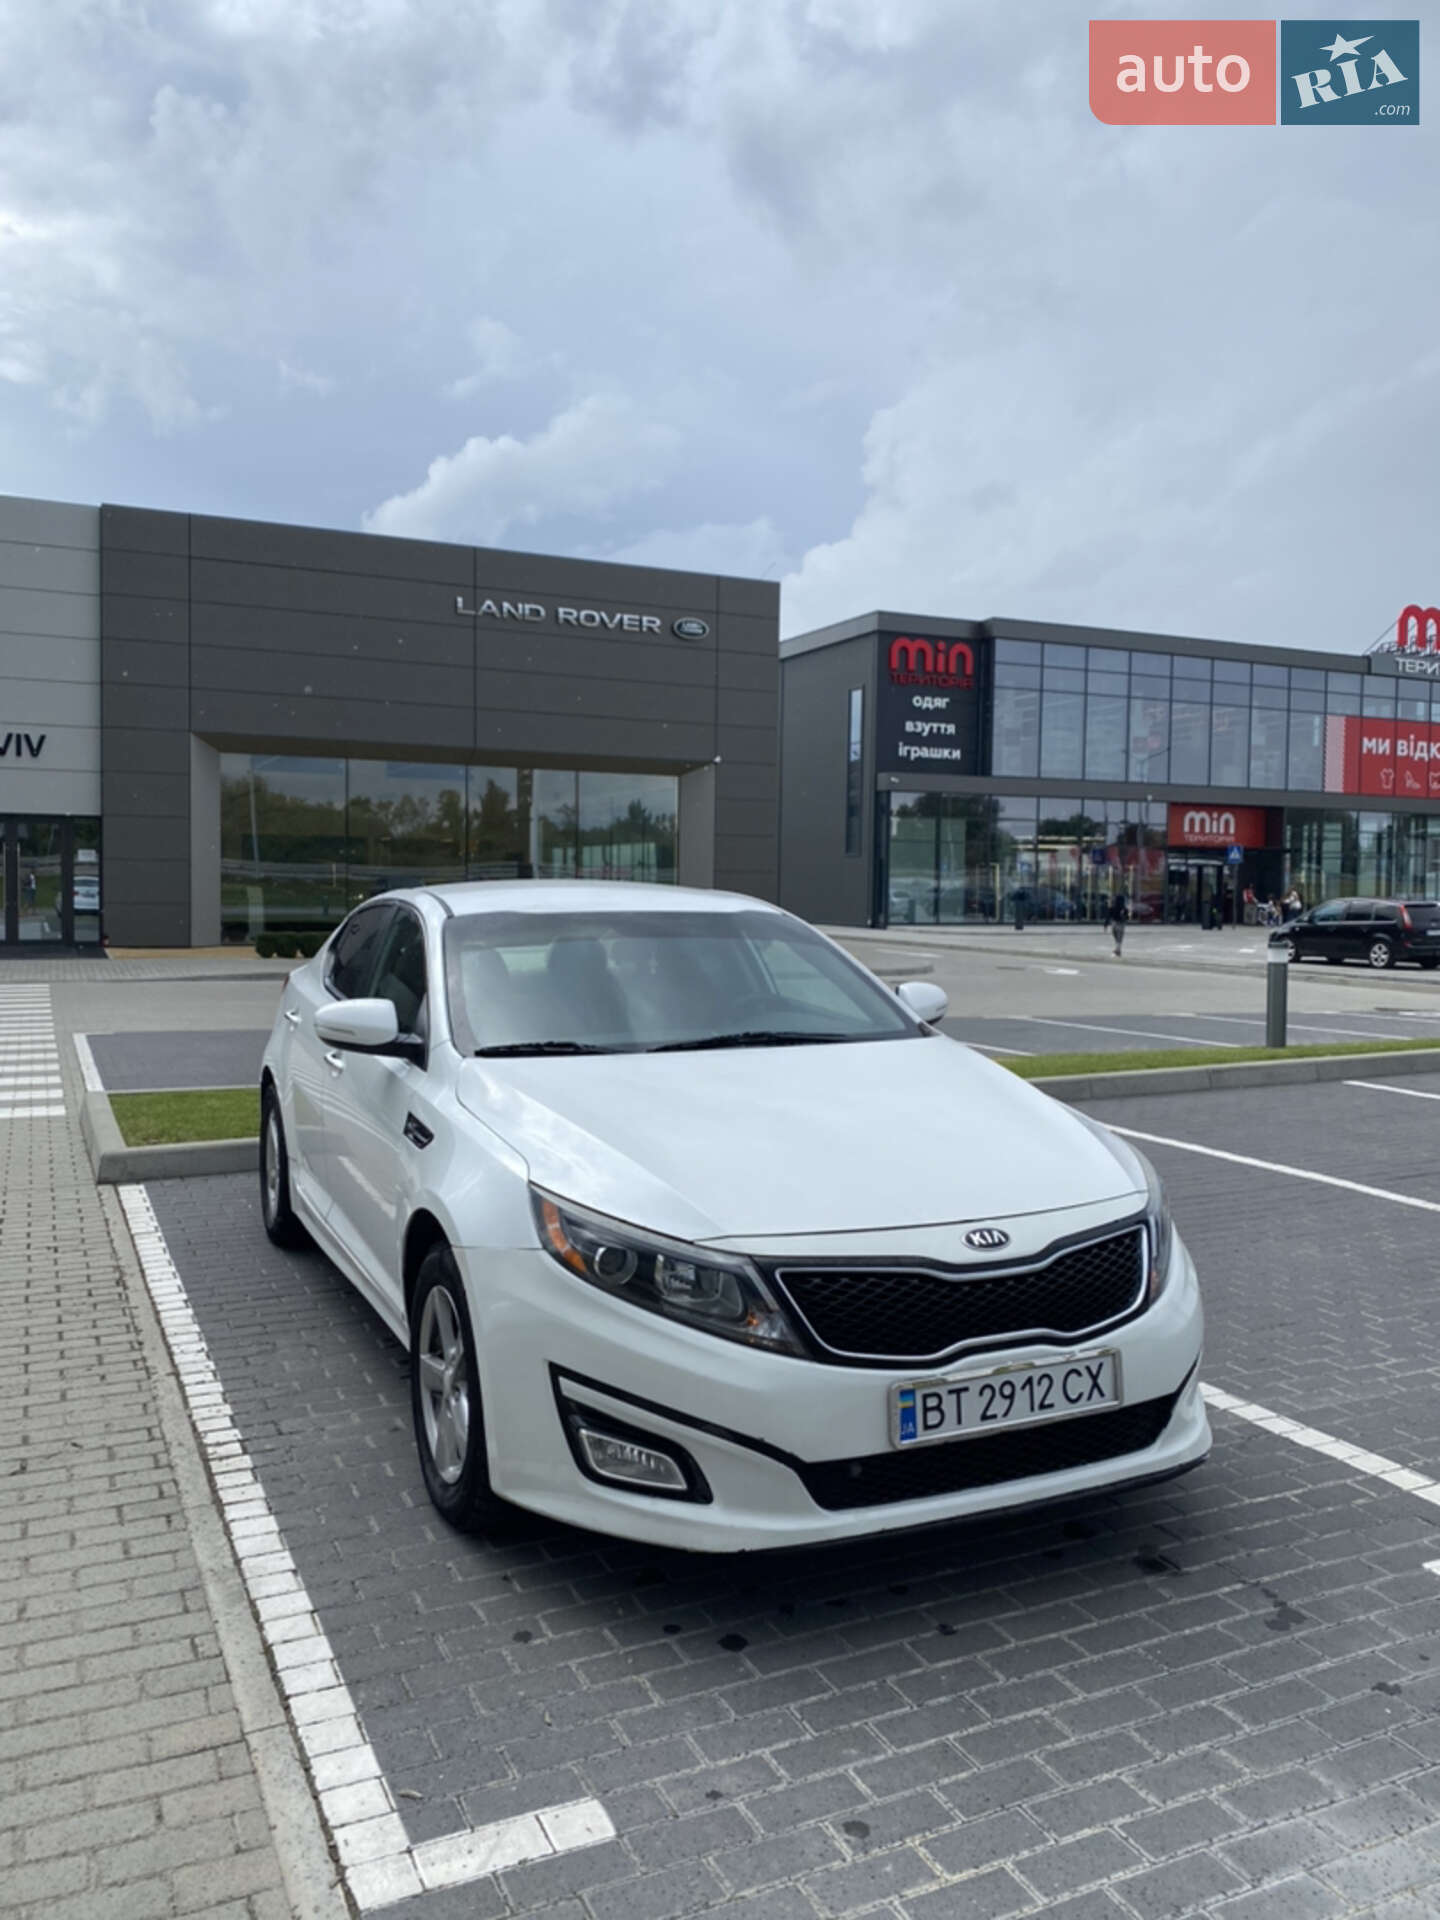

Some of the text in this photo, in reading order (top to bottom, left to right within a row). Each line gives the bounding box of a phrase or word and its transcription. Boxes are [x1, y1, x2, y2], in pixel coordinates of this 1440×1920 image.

[456, 596, 546, 622] LAND
[557, 606, 661, 634] ROVER
[912, 695, 950, 710] одяг
[905, 721, 956, 737] взуття
[898, 741, 961, 760] іграшки
[969, 1230, 1006, 1245] KIA
[921, 1362, 1105, 1430] BT 2912 CX
